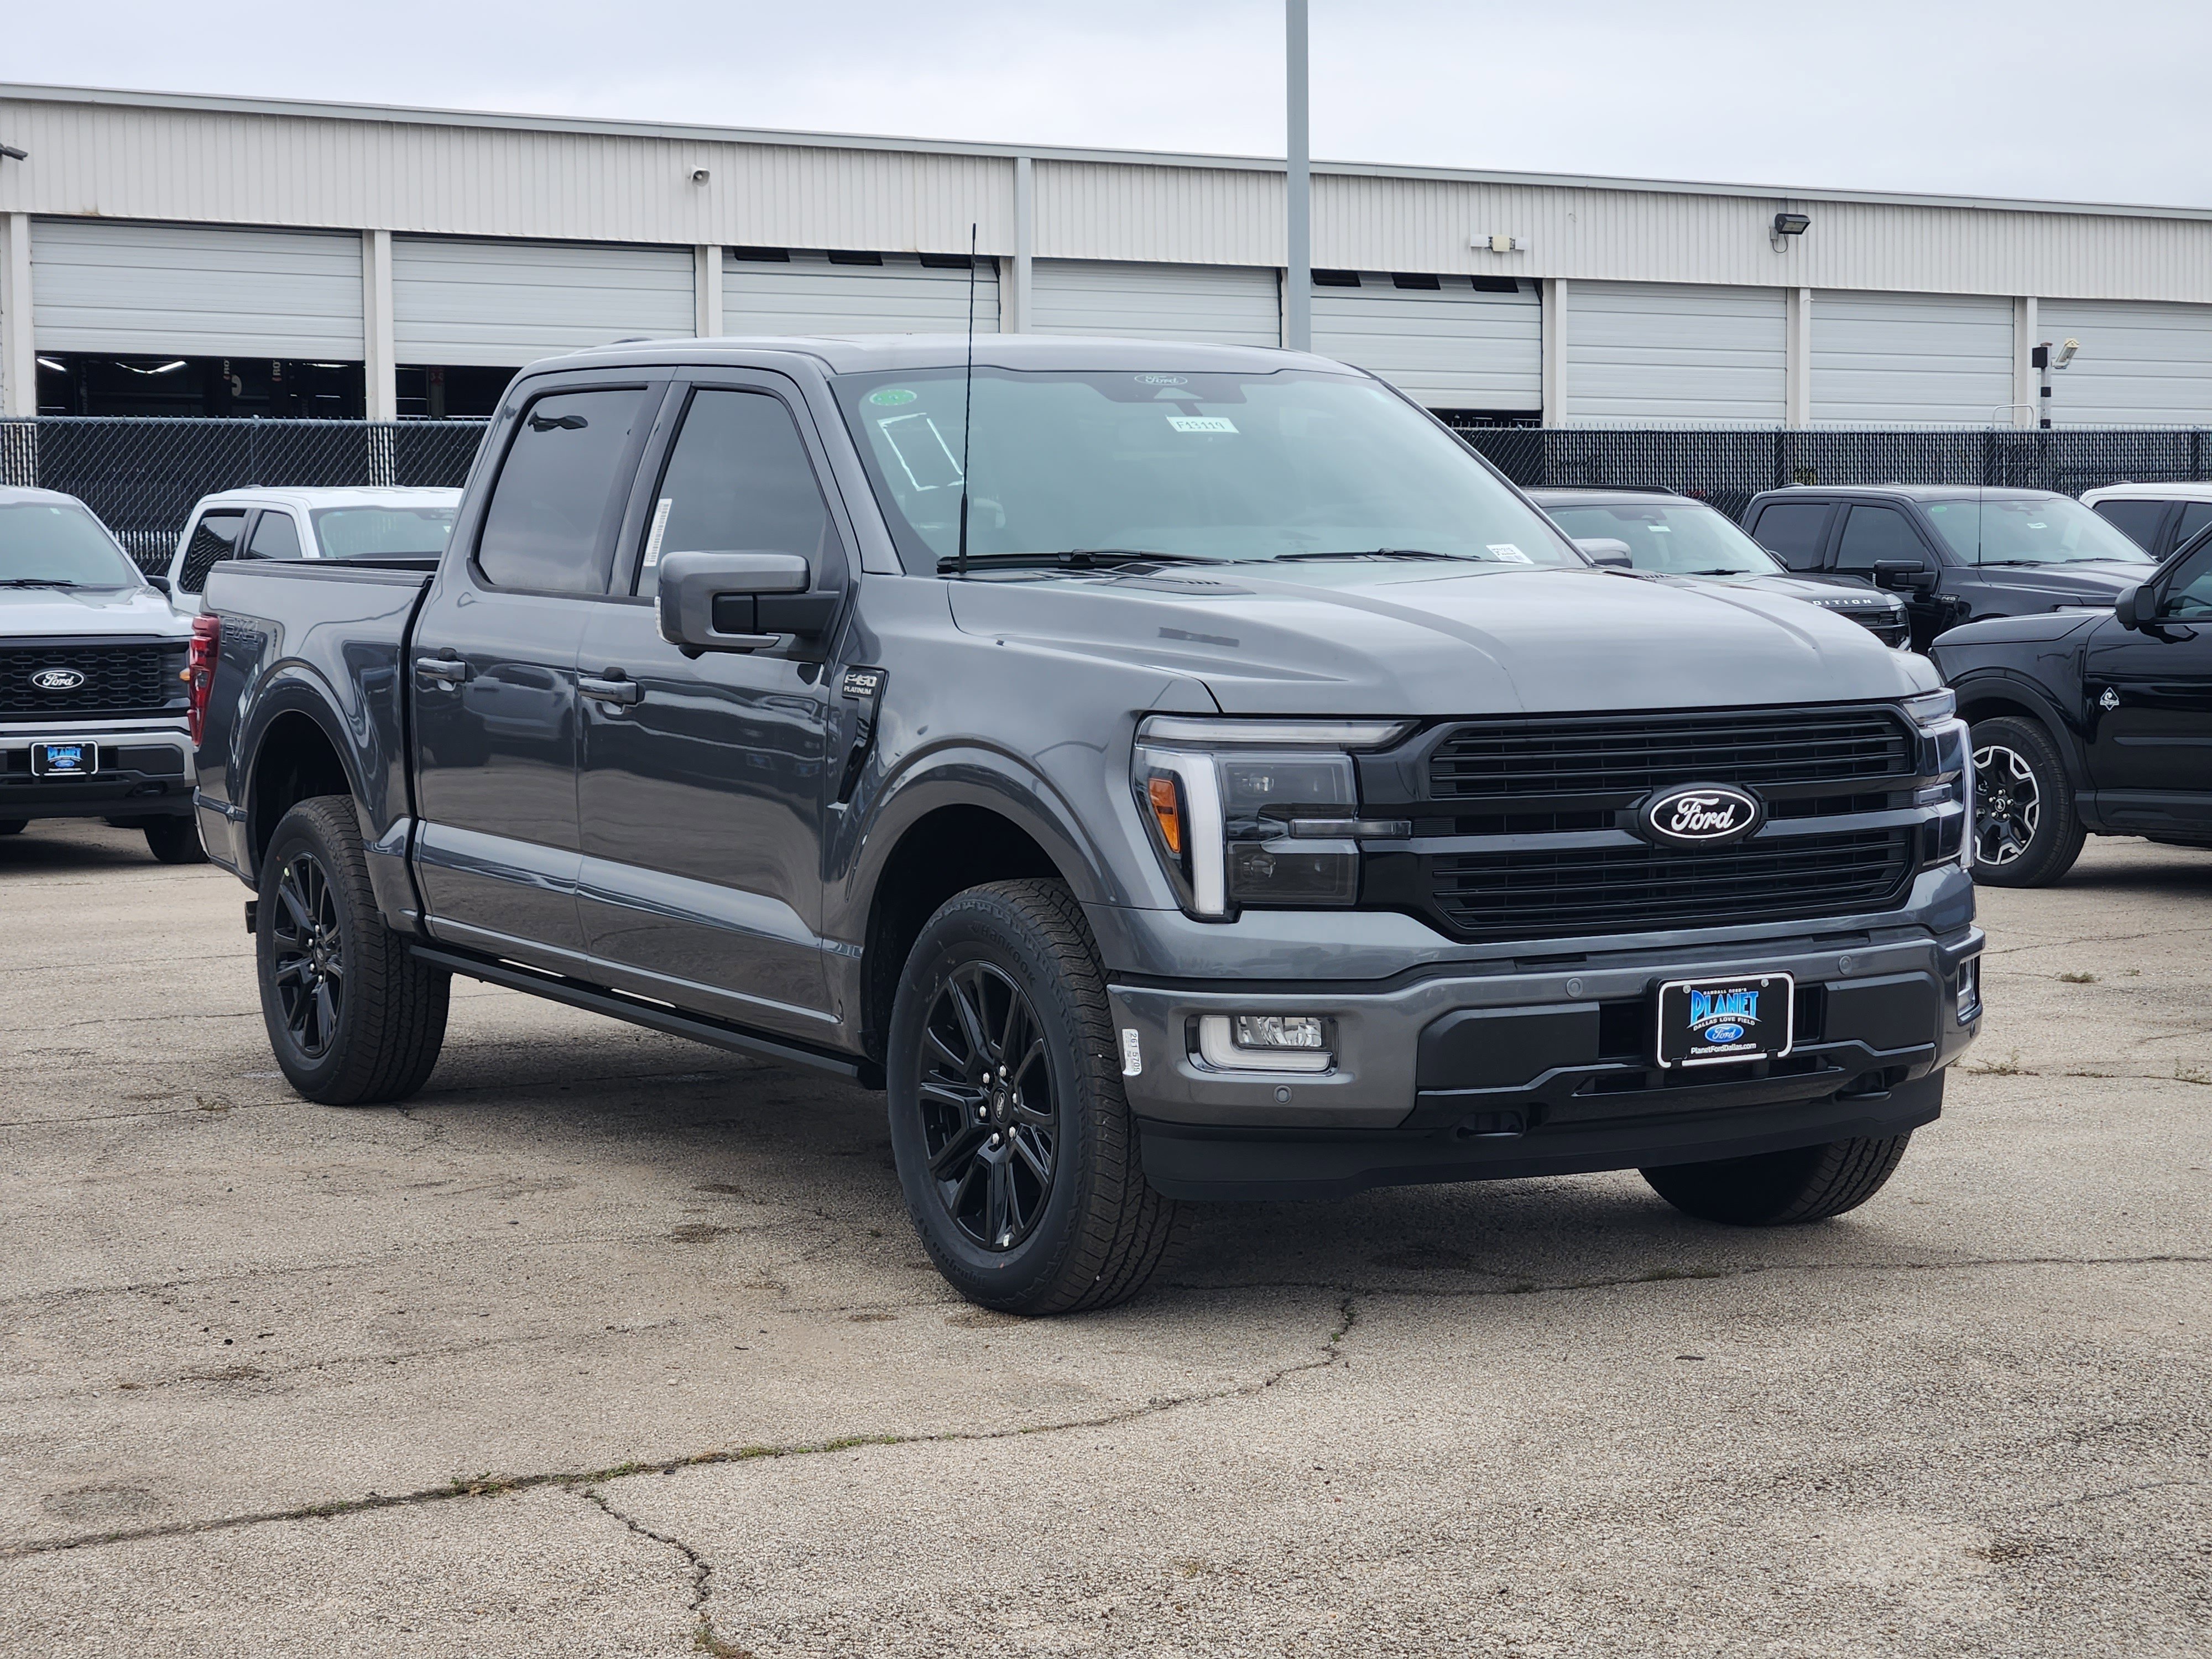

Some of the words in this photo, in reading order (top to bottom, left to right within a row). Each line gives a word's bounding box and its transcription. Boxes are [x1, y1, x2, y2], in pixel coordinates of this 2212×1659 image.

[1145, 375, 1179, 384] Ford
[221, 617, 259, 646] FX4
[42, 672, 75, 686] Ford
[844, 674, 878, 687] F-150
[843, 686, 872, 695] PLATINUM
[48, 746, 82, 761] PLANET
[1671, 797, 1736, 831] Ford
[981, 922, 1036, 988] Hankook
[1691, 990, 1759, 1024] PLANET
[1693, 1019, 1717, 1031] DALLAS
[1130, 1032, 1138, 1048] 261
[1712, 1026, 1736, 1040] Ford
[1691, 1043, 1756, 1054] PlanetFordDallas.com
[1132, 1052, 1141, 1072] 5709
